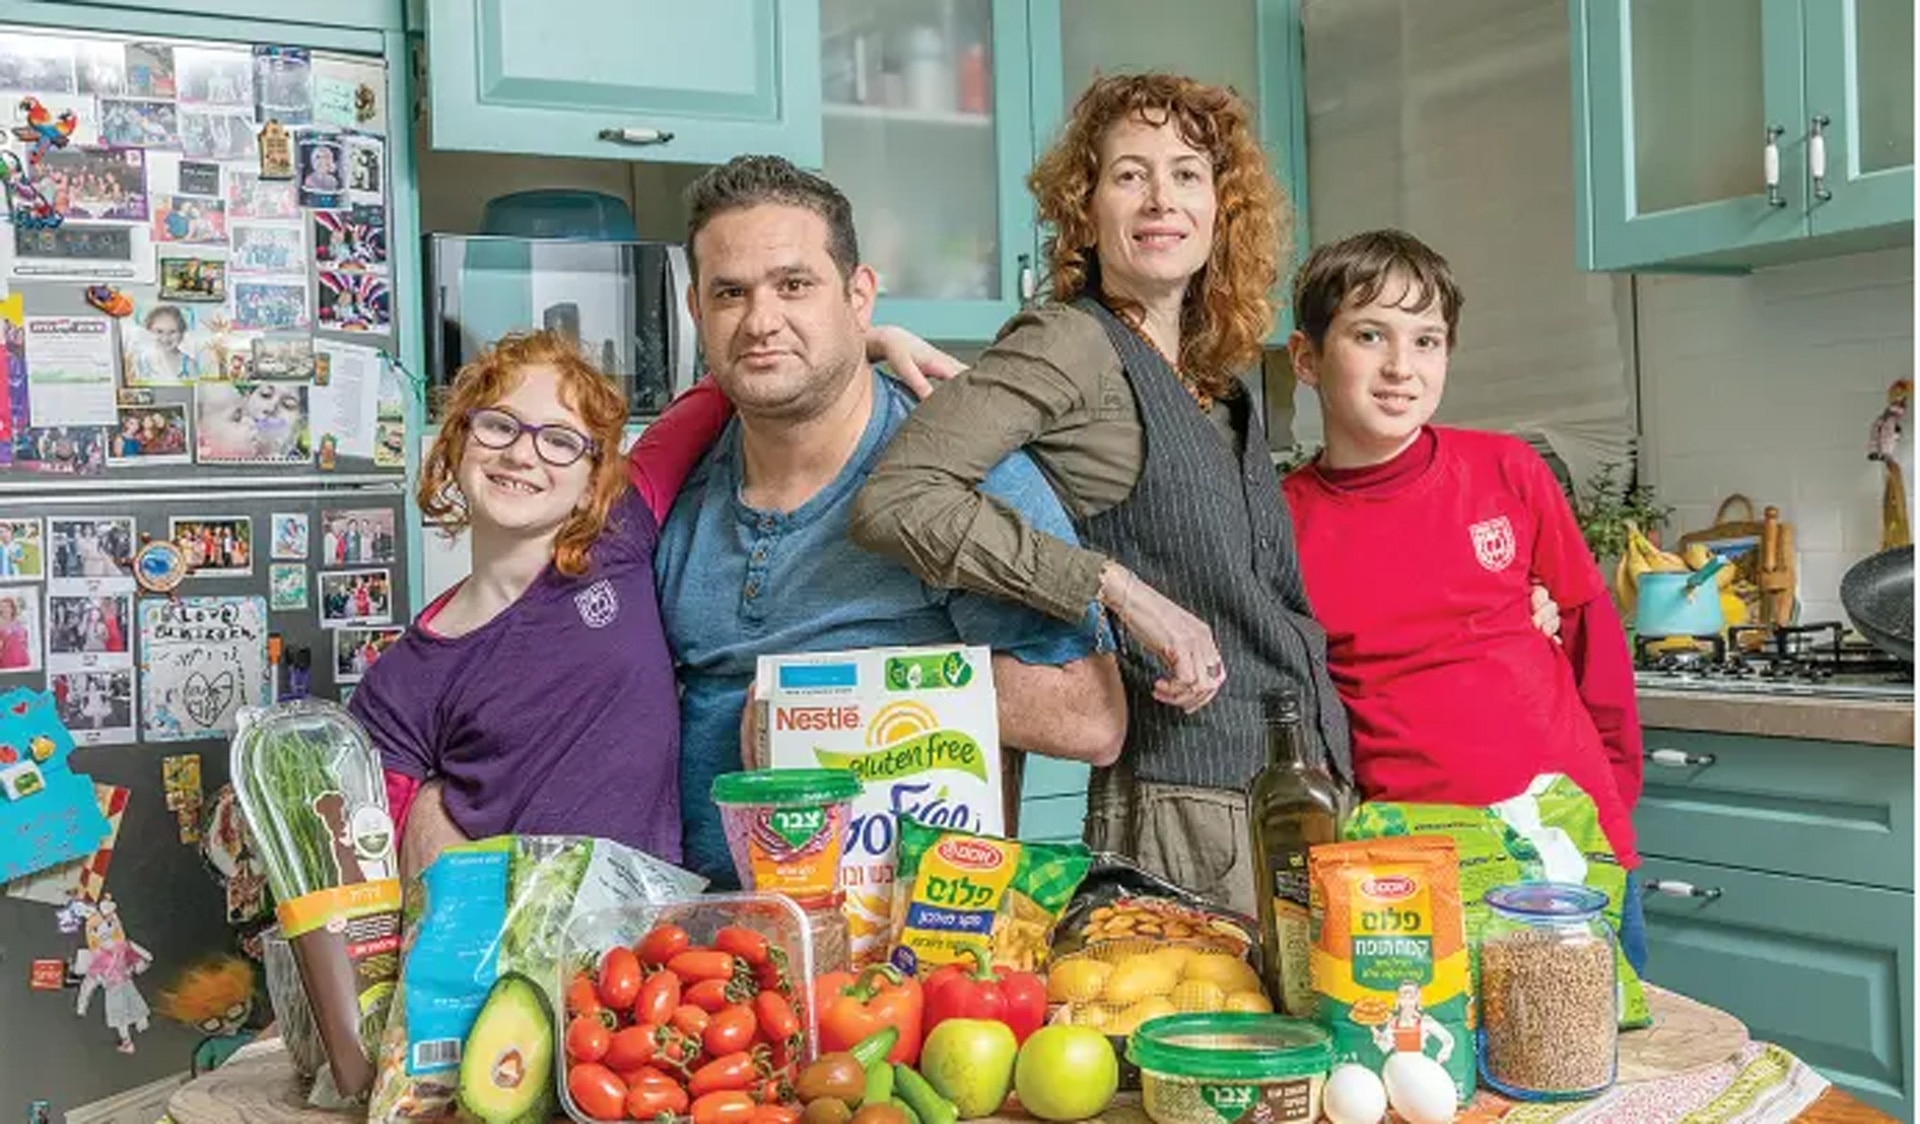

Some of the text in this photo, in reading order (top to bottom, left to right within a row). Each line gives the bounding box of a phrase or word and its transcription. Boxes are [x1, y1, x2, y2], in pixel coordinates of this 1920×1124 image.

[850, 732, 975, 778] gluten free
[775, 811, 820, 828] צבר
[1361, 907, 1421, 931] פלוס
[1207, 1086, 1252, 1105] צבר
